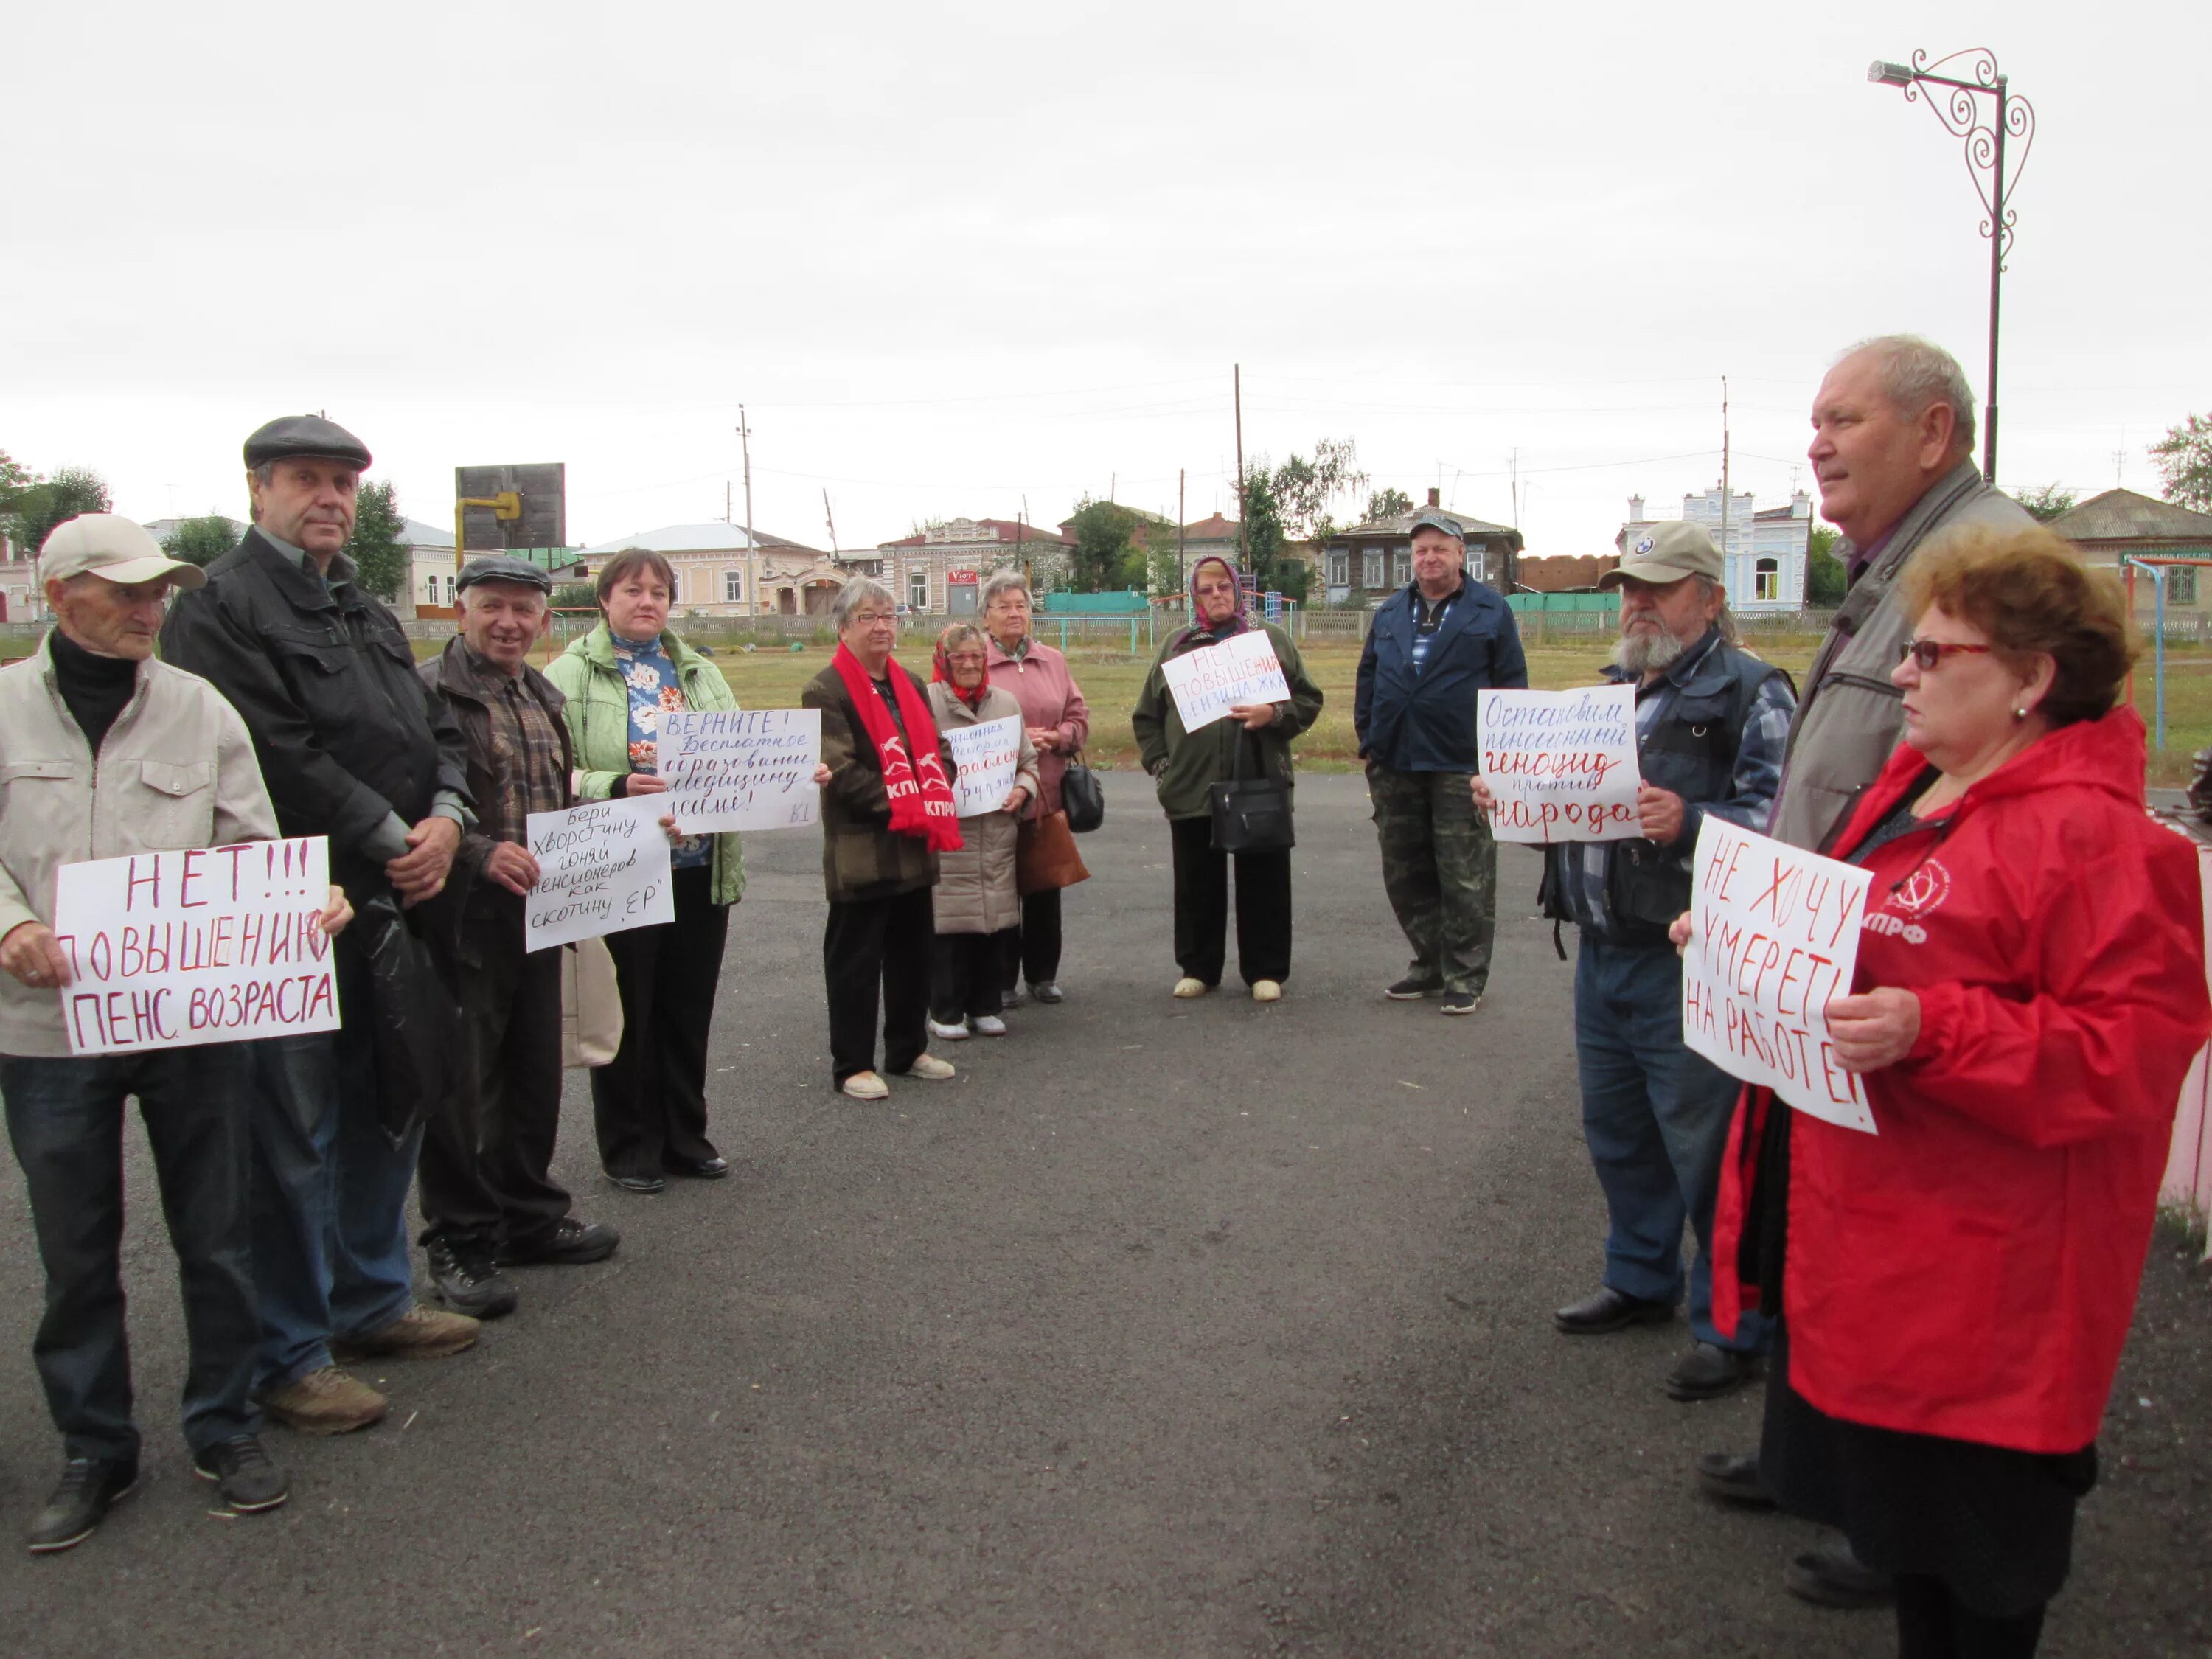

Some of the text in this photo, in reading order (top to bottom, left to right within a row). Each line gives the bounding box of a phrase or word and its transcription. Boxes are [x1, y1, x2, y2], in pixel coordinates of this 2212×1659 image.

[1192, 639, 1235, 672] НЕТ
[1173, 655, 1280, 703] ПОВЫШЕНИЯ
[1258, 672, 1287, 692] ЖКХ
[1486, 693, 1623, 728] Остановим
[1486, 723, 1628, 751] пенсионный
[665, 771, 807, 797] медицину
[1486, 751, 1621, 785] геноцид
[886, 780, 919, 799] КП
[1513, 773, 1599, 801] против
[568, 806, 611, 826] Бери
[1493, 797, 1641, 842] народа
[558, 839, 609, 870] гоняй
[529, 849, 636, 897] пенсионеров
[568, 882, 609, 898] как
[1704, 832, 1750, 902] НЕ
[1750, 857, 1860, 949] ХОЧУ
[532, 897, 613, 928] скотину
[58, 909, 330, 981] ПОВЫШЕНИЮ
[189, 973, 333, 1029] ВОЗРАСТА
[1687, 977, 1717, 1041] НА
